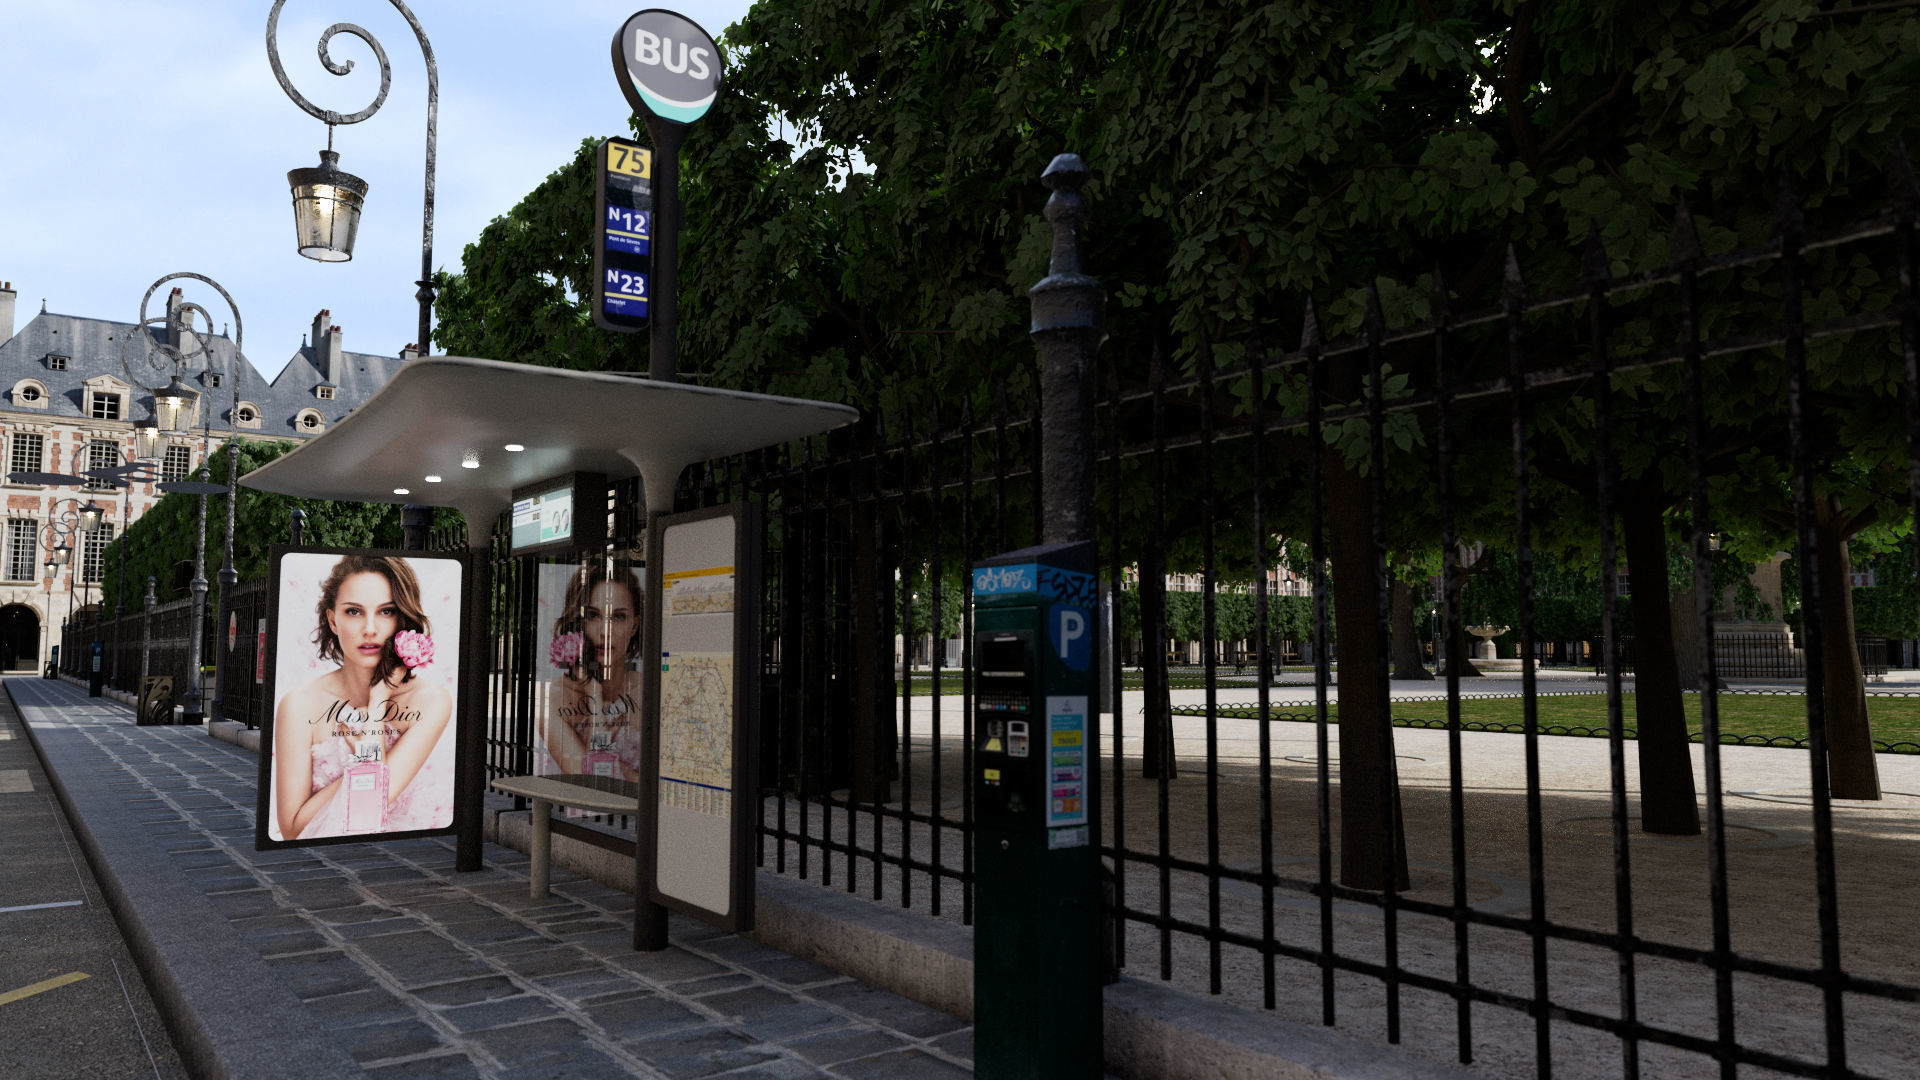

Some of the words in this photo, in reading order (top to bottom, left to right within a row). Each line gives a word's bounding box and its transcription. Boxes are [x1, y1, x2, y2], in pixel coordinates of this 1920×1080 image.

[635, 28, 710, 80] BUS
[613, 146, 645, 174] 75
[1060, 610, 1085, 658] P
[308, 699, 370, 725] Miss
[373, 699, 422, 723] Dior
[331, 730, 358, 738] ROSE
